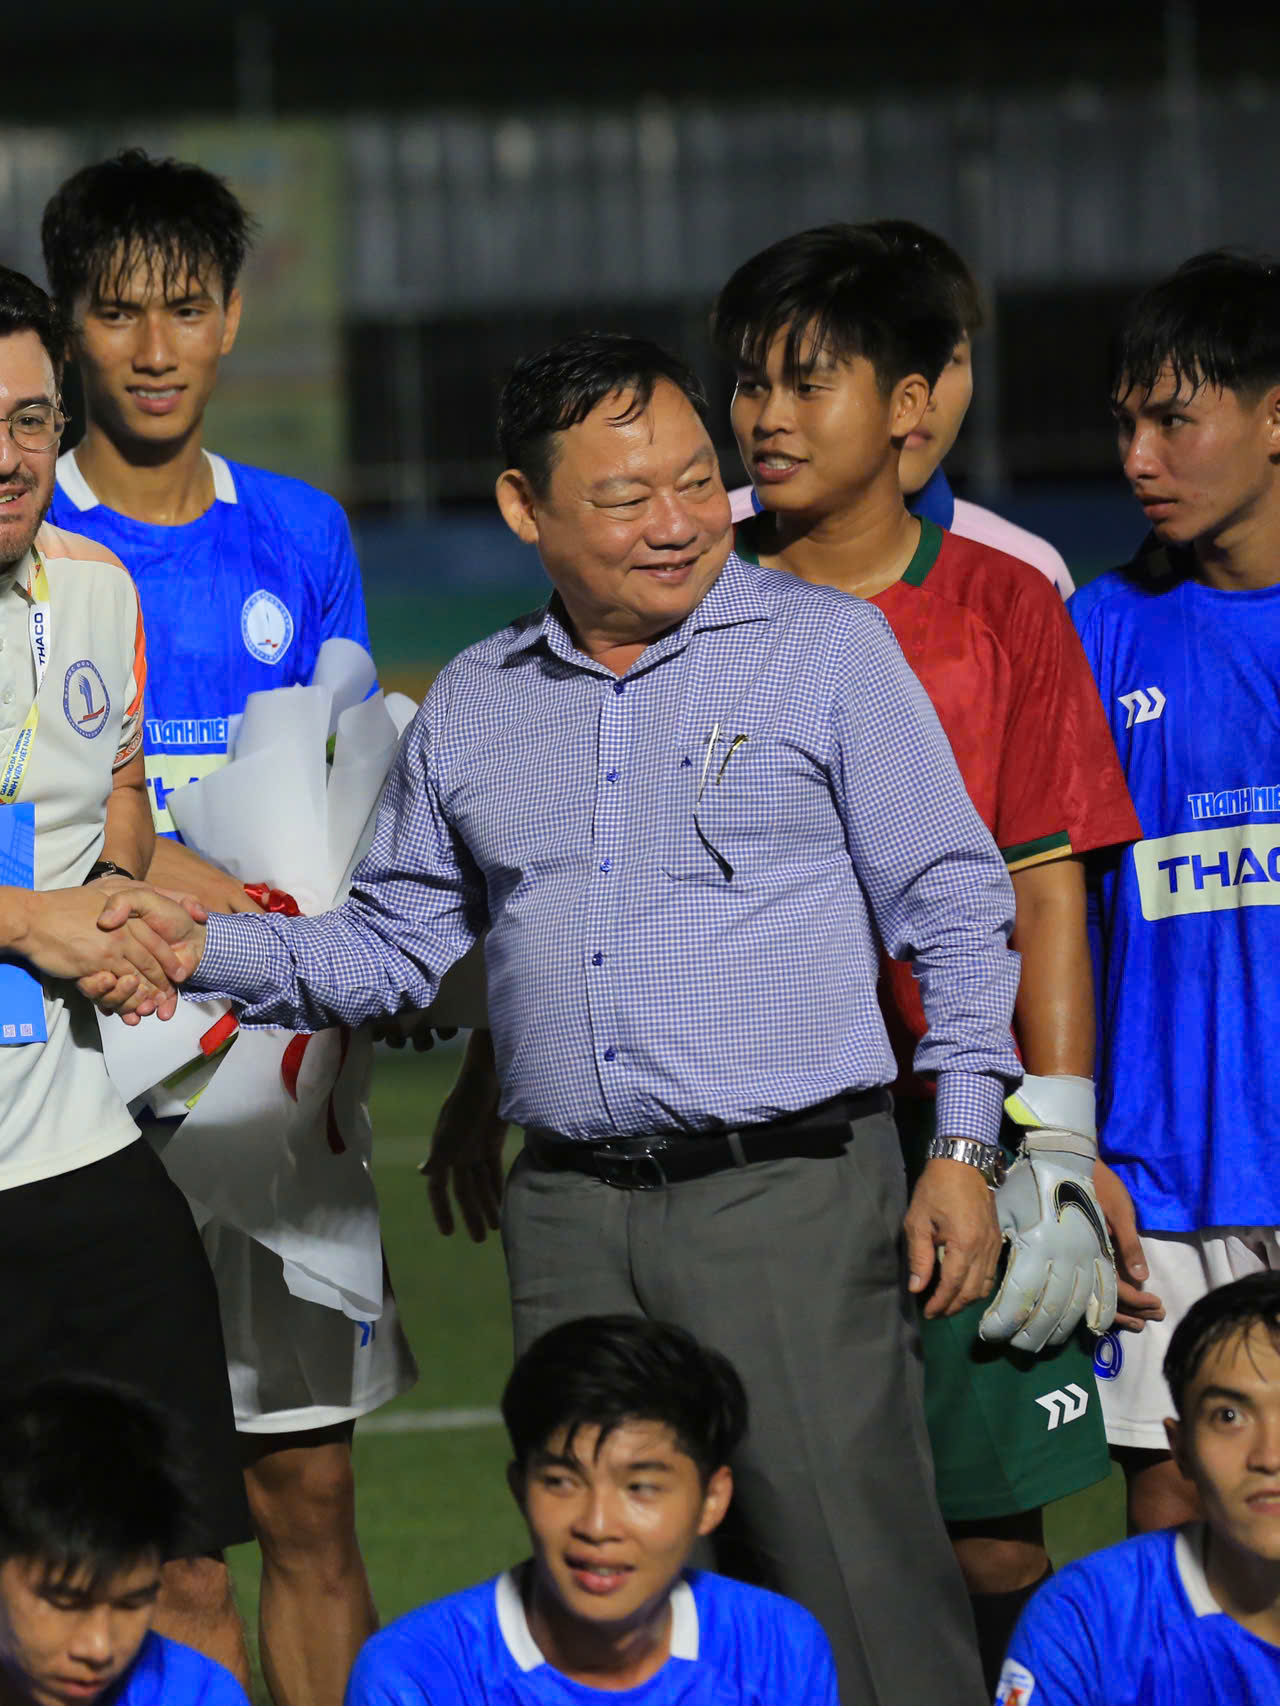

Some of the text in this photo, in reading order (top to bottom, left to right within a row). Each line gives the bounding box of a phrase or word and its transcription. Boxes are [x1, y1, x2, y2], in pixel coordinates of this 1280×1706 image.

[34, 612, 45, 666] THACO
[23, 728, 32, 746] NAM
[146, 717, 228, 744] TANH NIÊ
[1188, 787, 1252, 820] THANH
[1158, 846, 1280, 894] THA
